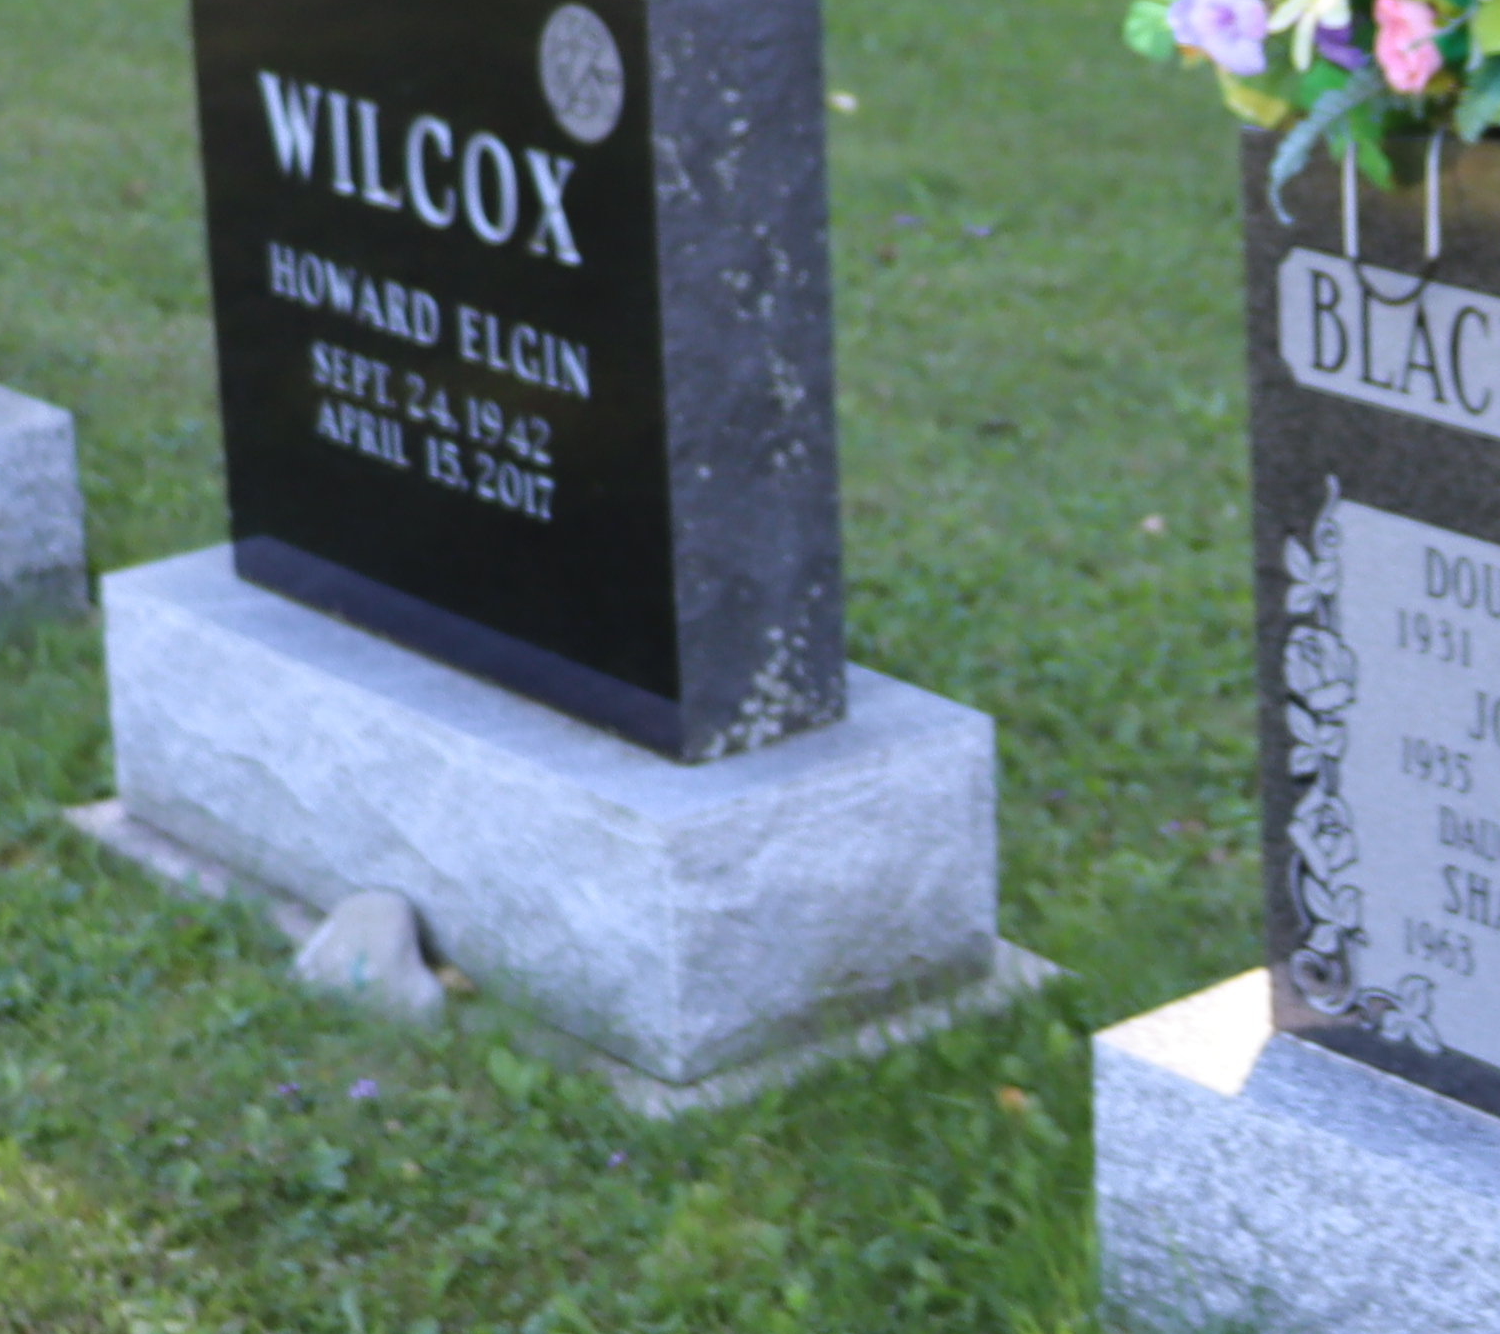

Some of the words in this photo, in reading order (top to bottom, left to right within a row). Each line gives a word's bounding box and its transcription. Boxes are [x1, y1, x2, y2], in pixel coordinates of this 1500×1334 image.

[257, 69, 584, 267] WILCOX
[268, 241, 440, 347] HOWARD
[457, 303, 591, 399] ELGIN
[316, 400, 411, 467] APRIL
[473, 450, 557, 523] 2017
[465, 396, 553, 466] 1942
[1398, 610, 1471, 668] 1931
